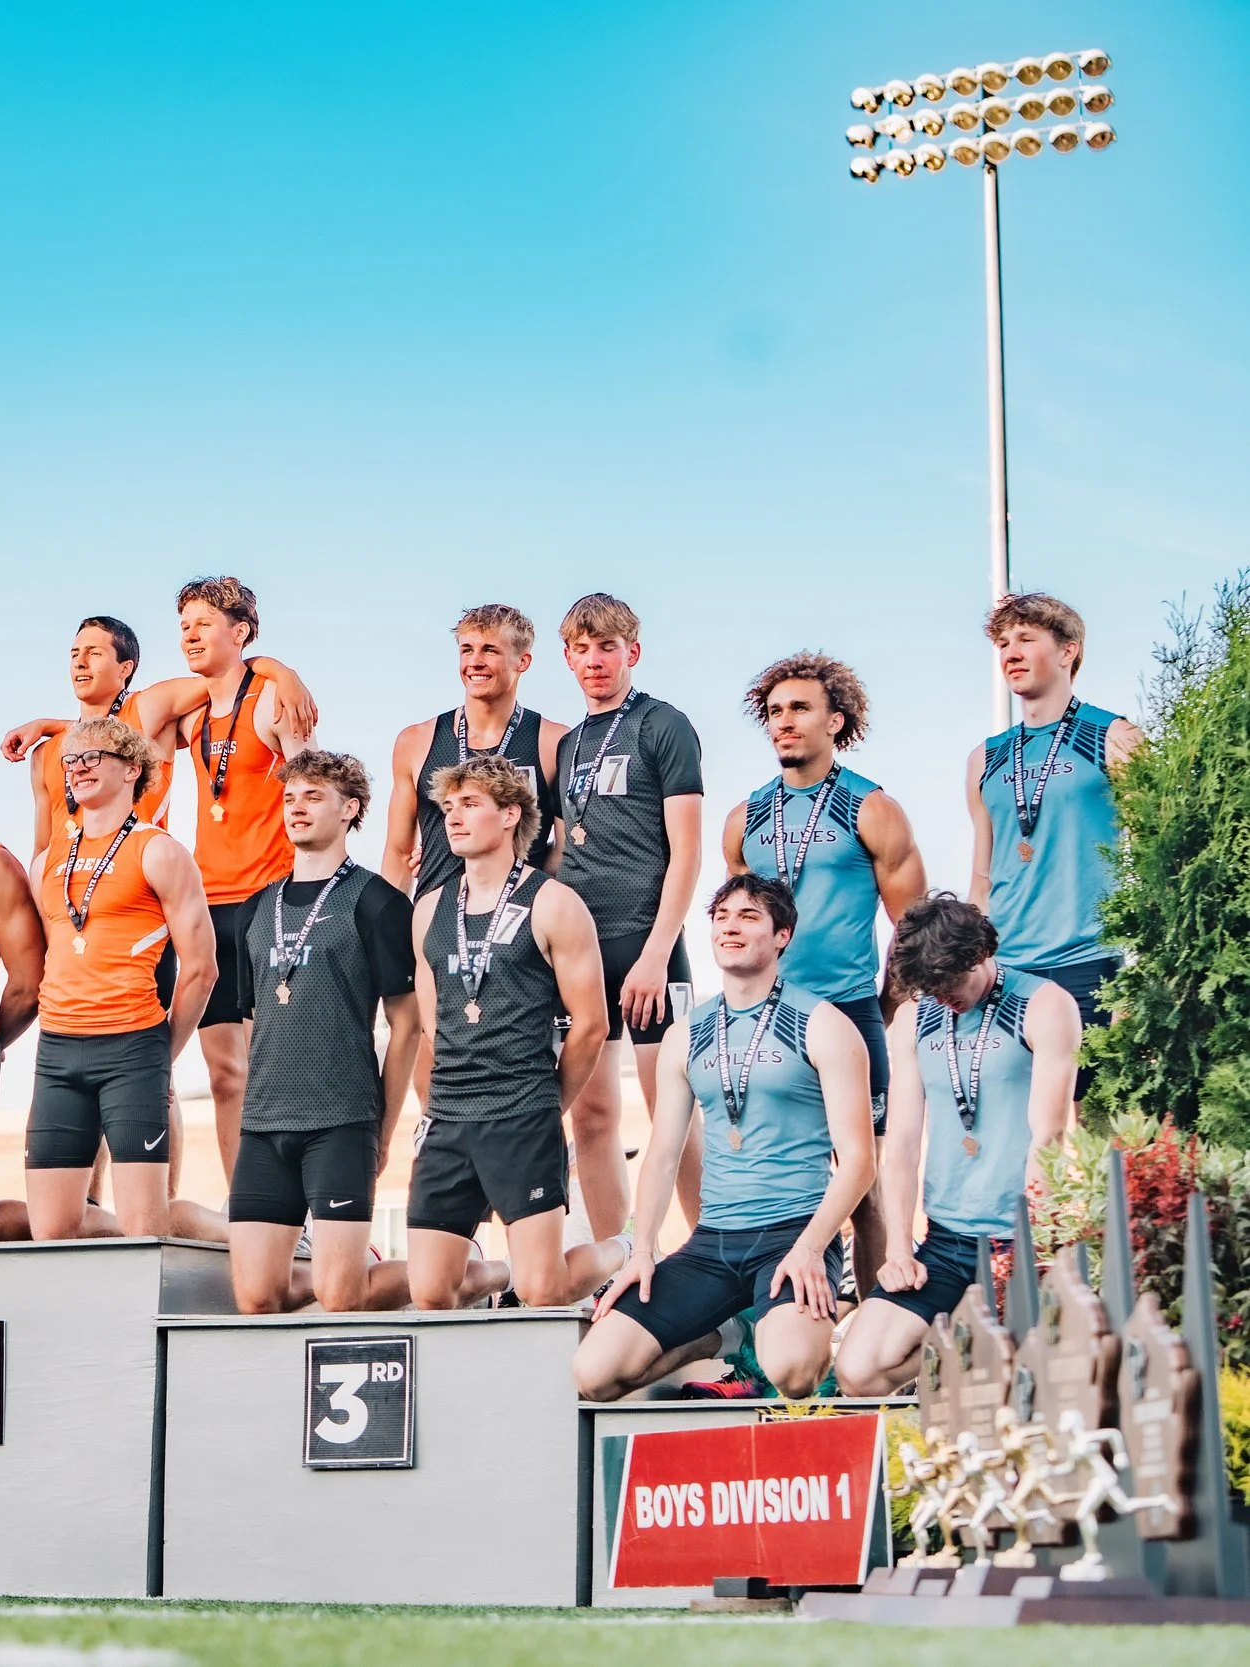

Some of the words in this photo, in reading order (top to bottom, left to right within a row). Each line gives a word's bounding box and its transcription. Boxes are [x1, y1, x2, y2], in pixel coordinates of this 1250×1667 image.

[607, 758, 624, 793] 7
[497, 907, 523, 941] 7
[635, 1482, 706, 1529] BOYS
[711, 1474, 830, 1526] DIVISION
[836, 1473, 851, 1520] 1
